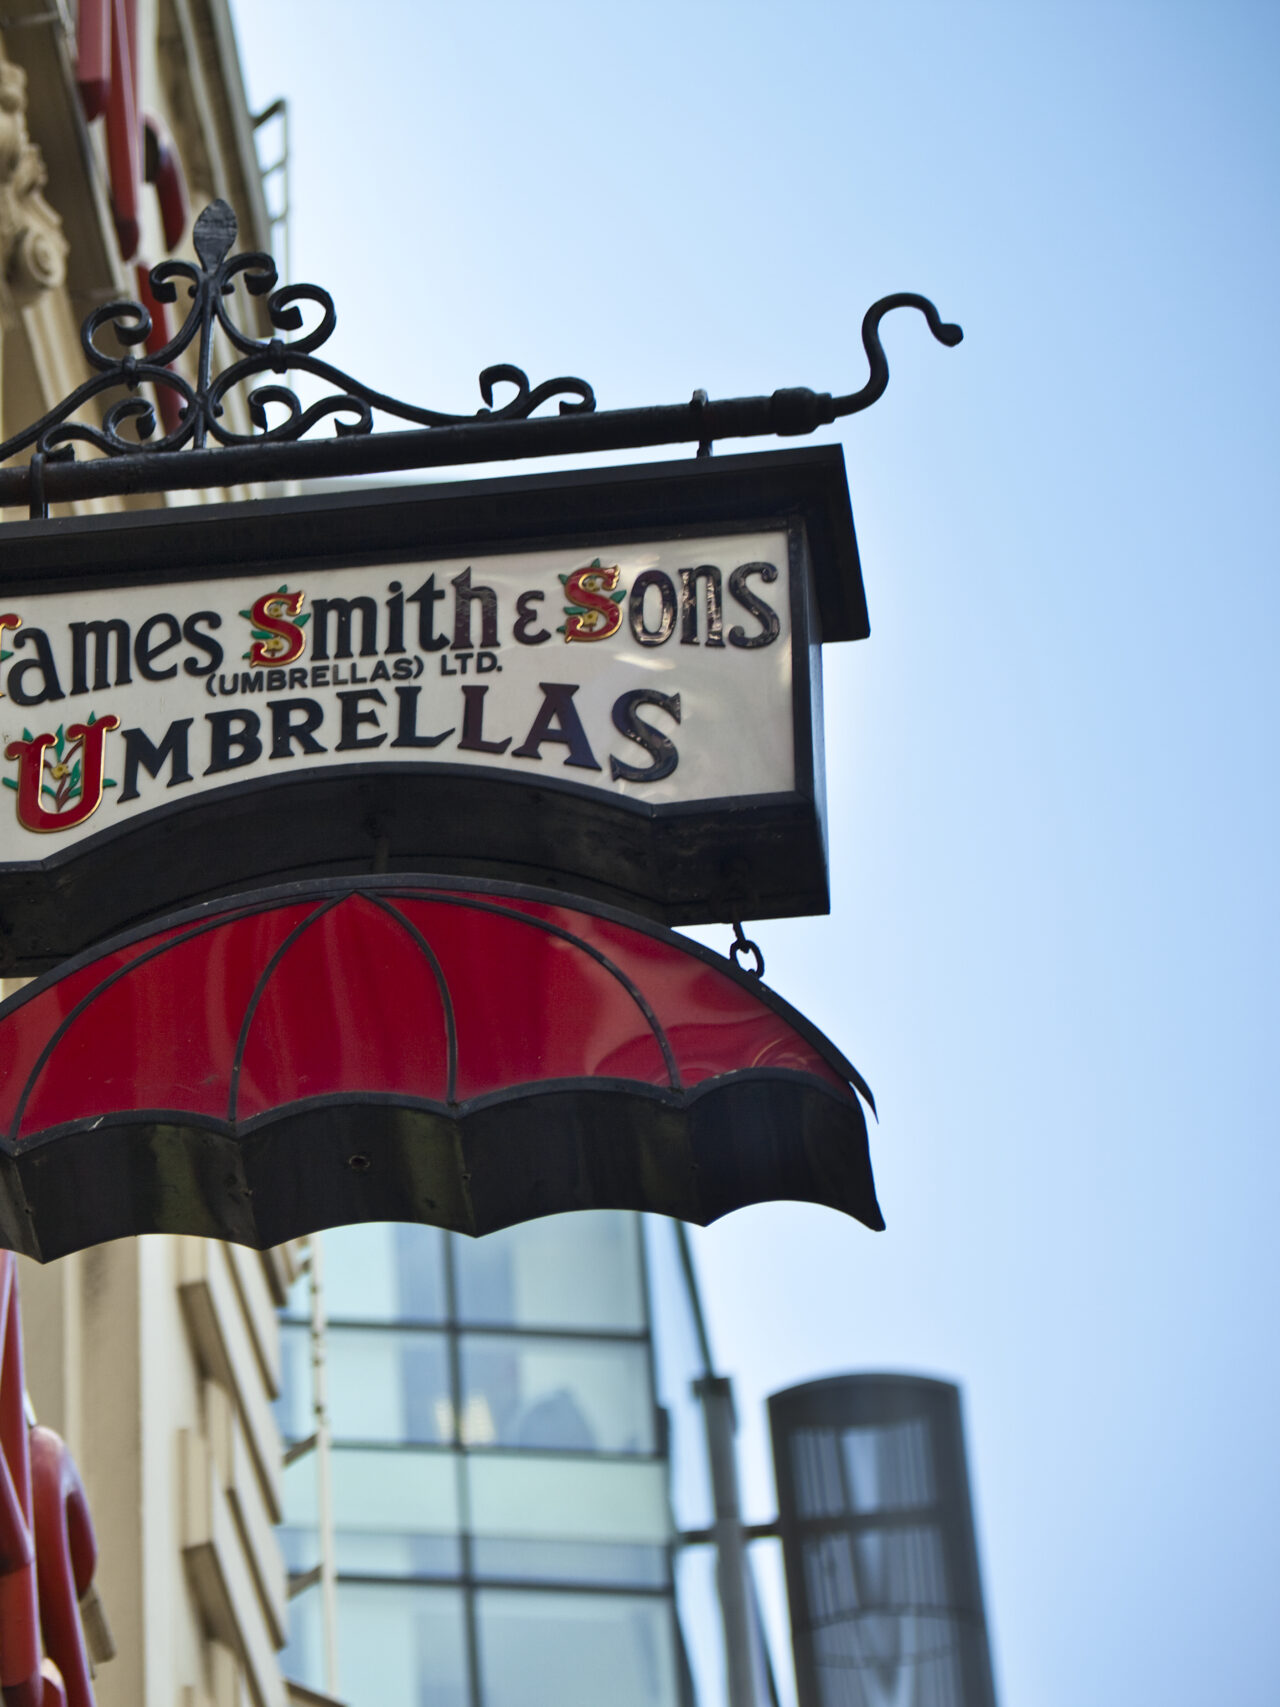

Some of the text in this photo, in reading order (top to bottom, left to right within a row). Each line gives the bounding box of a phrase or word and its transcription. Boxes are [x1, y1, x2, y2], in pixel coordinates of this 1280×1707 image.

[242, 566, 501, 668] Smith
[561, 561, 781, 650] Sons
[205, 651, 503, 698] (UMBRELLAS) LTD.
[4, 682, 682, 834] UMBRELLAS
